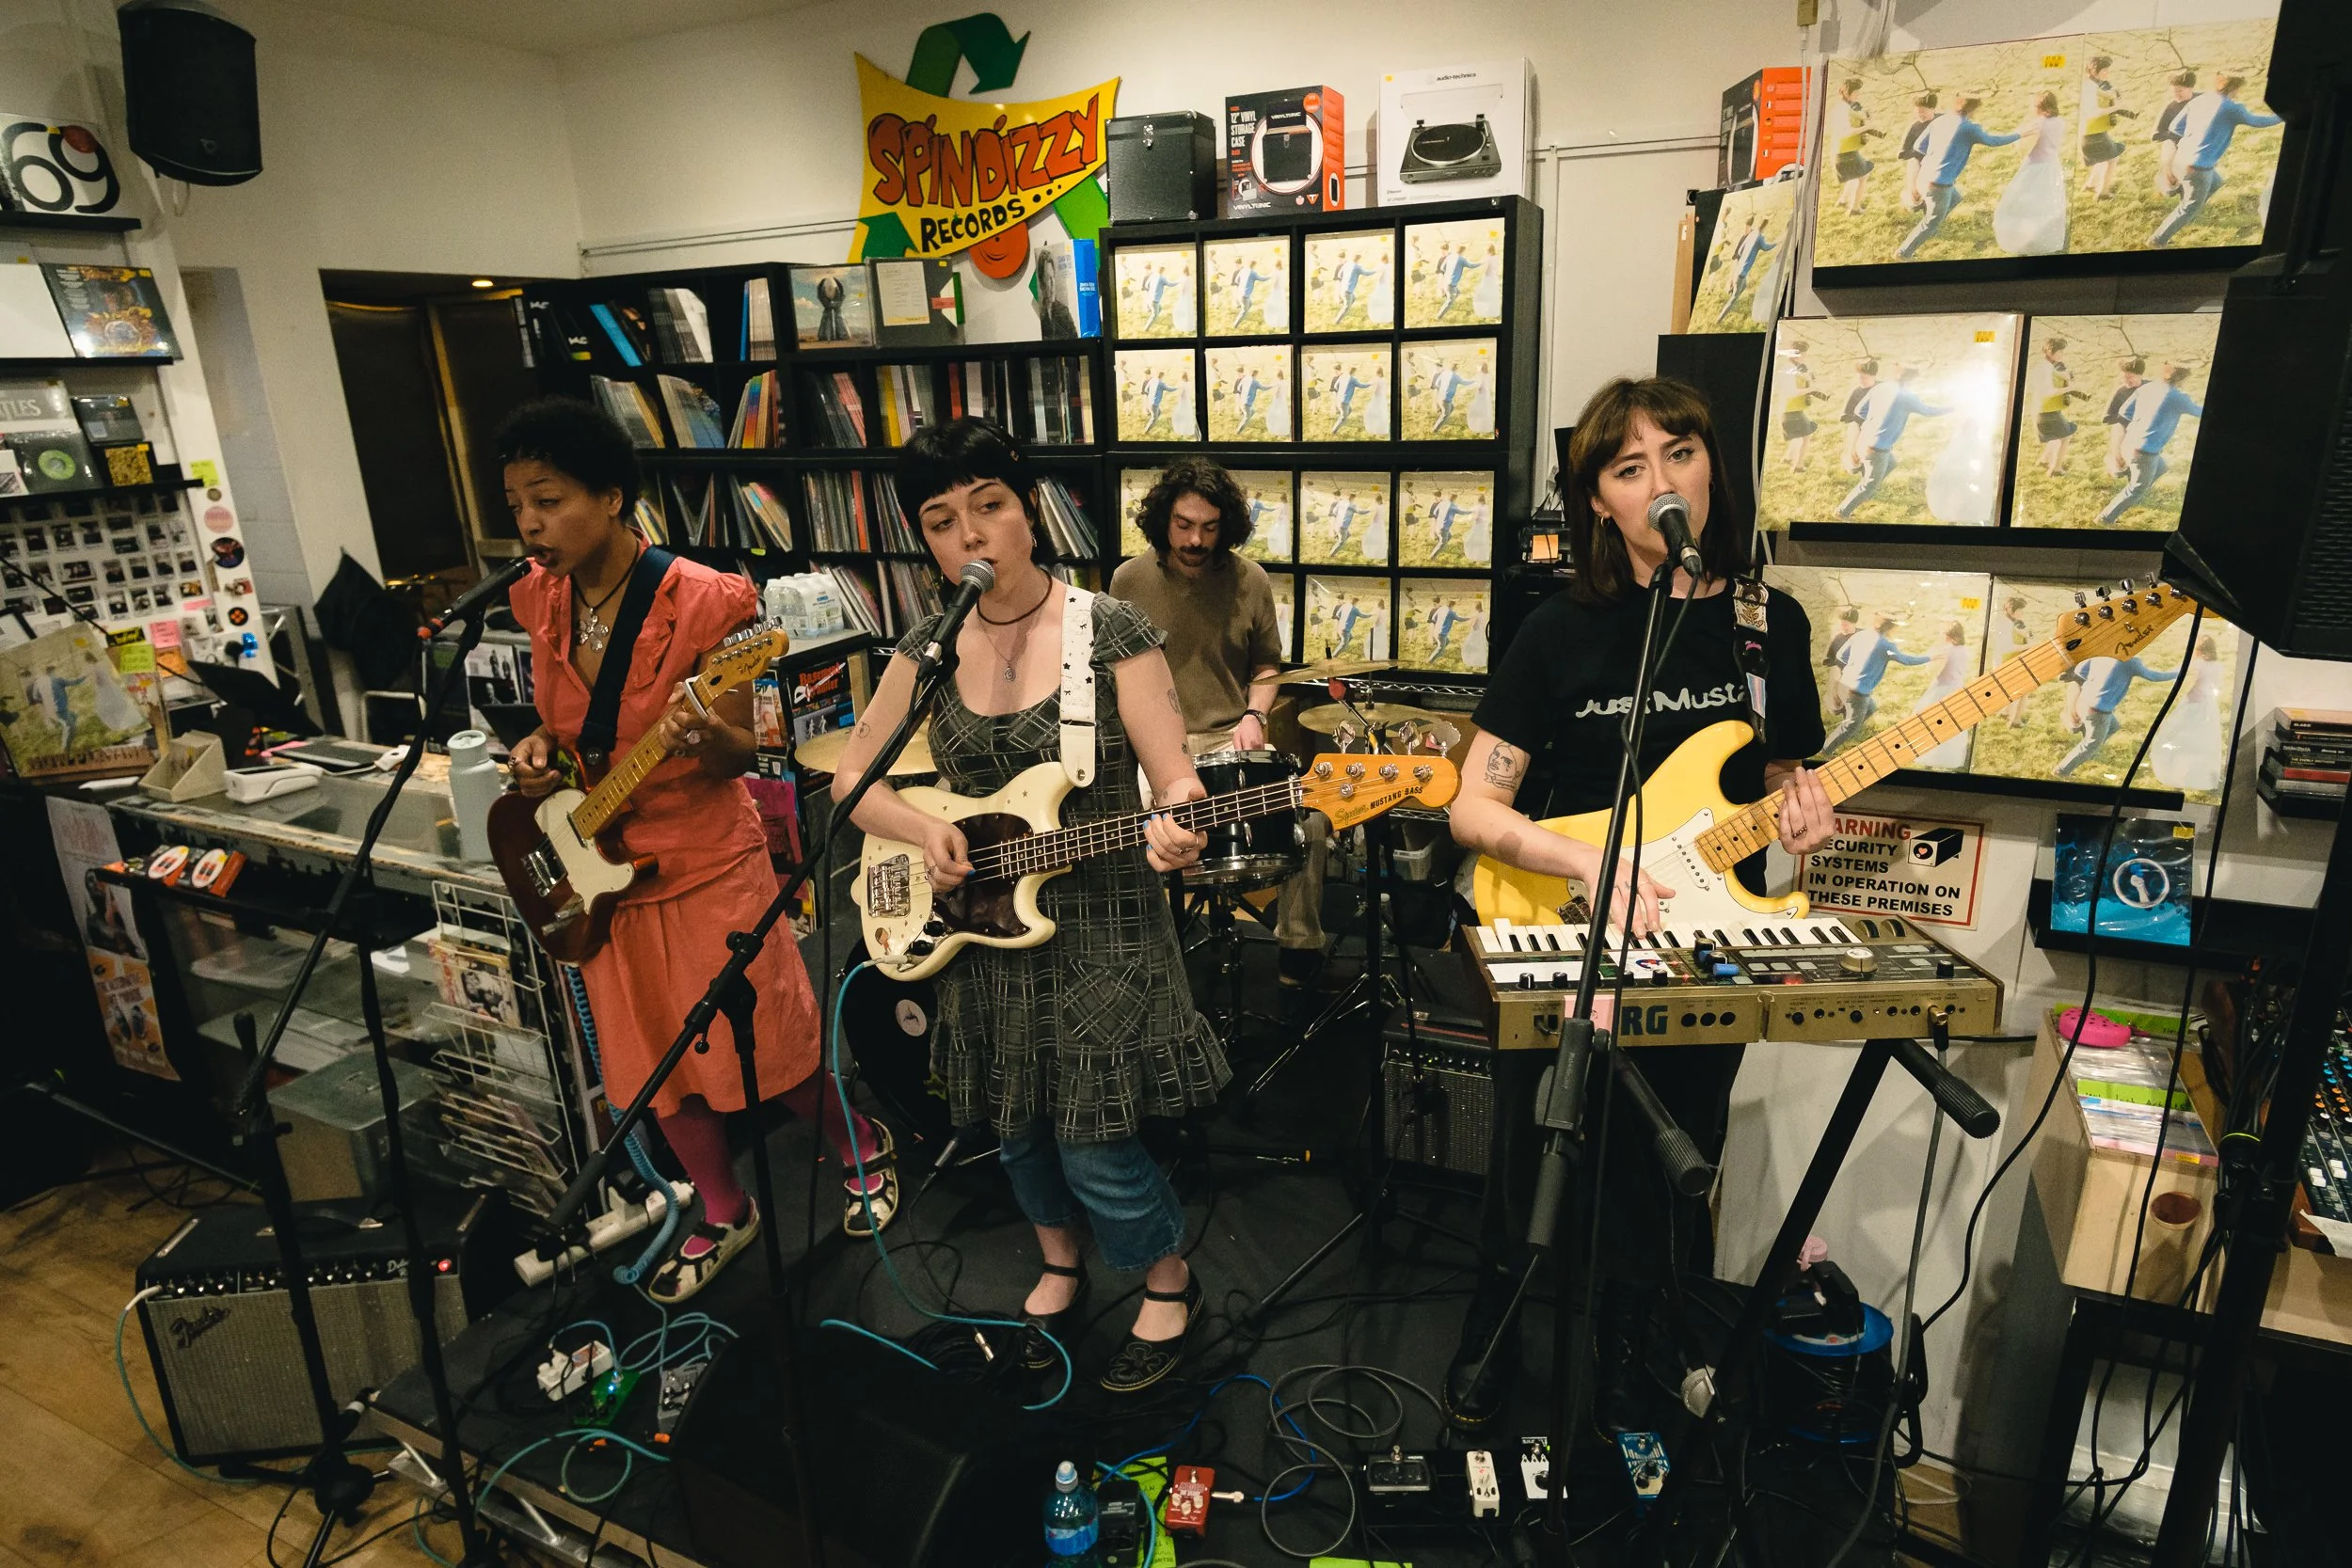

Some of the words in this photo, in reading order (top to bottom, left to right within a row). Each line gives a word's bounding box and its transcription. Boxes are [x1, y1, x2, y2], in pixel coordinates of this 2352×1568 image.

[1437, 72, 1477, 82] audio-technica
[1241, 110, 1257, 122] VINYL
[1231, 122, 1256, 135] STORAGE
[867, 92, 1099, 209] SPINDIZZY
[1231, 136, 1246, 148] CASE
[2, 121, 120, 214] 69
[920, 198, 1025, 253] RECORDS
[2114, 624, 2154, 657] Fender
[1370, 790, 1402, 810] MUSTANG
[1404, 786, 1423, 796] BASS
[1835, 817, 1912, 840] ARNING
[1826, 839, 1898, 856] ECURITY
[1811, 855, 1889, 873] SYSTEMS
[1809, 872, 1827, 885] IN
[1832, 876, 1929, 895] OPERATION
[1934, 885, 1961, 899] ON
[1807, 890, 1862, 906] THESE
[1867, 895, 1953, 916] PREMISES
[1621, 1005, 1668, 1036] RG
